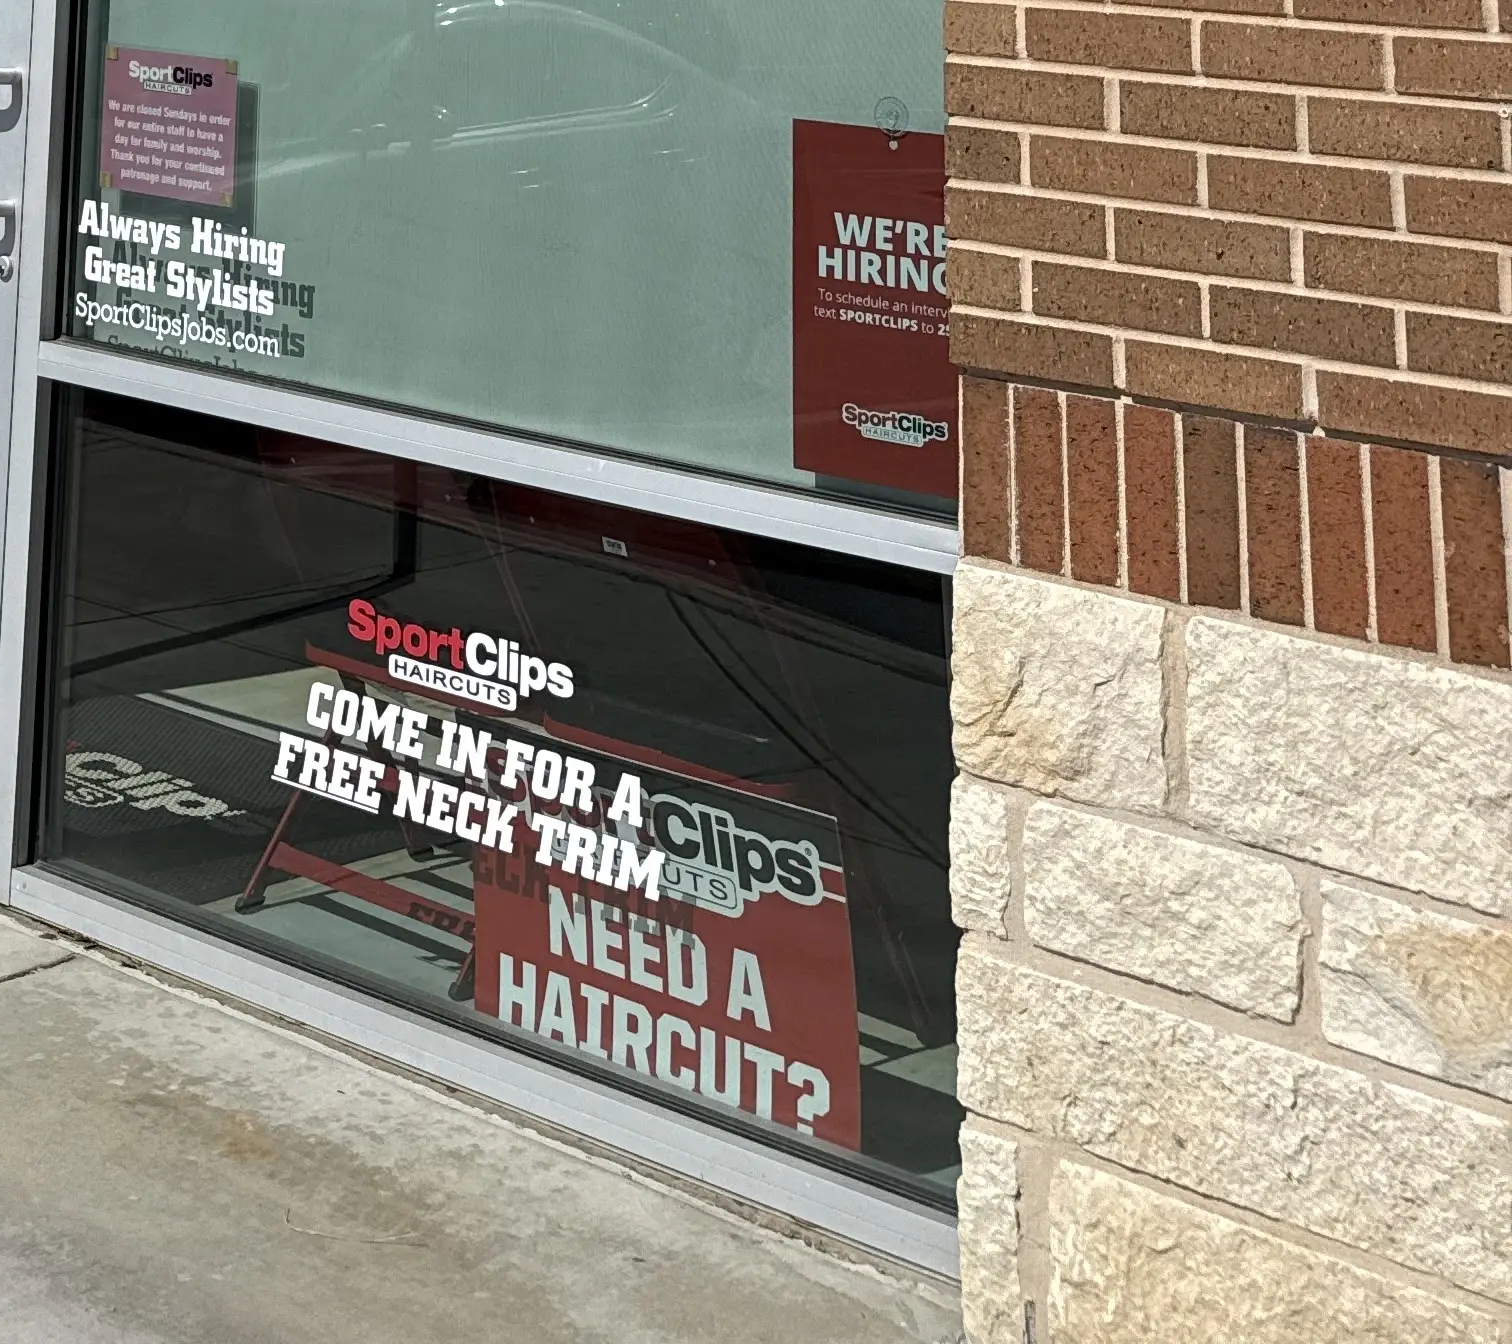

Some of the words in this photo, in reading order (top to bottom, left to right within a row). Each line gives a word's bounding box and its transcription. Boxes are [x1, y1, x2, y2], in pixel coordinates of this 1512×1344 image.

[144, 82, 190, 94] HAIRCUTS
[108, 99, 120, 110] We
[122, 103, 135, 113] are
[136, 104, 162, 117] closed
[163, 107, 197, 123] Sundays
[199, 112, 207, 122] in
[209, 114, 231, 126] order
[114, 116, 125, 128] for
[127, 120, 140, 129] our
[142, 121, 165, 134] entire
[167, 125, 185, 137] staff
[186, 127, 195, 138] to
[197, 128, 216, 141] have
[110, 148, 134, 161] Thank
[135, 154, 150, 166] you
[151, 155, 162, 167] for
[164, 158, 183, 170] your
[184, 161, 225, 177] continued
[114, 132, 128, 147] day
[130, 135, 142, 147] for
[143, 137, 168, 152] family
[169, 142, 185, 153] and
[186, 144, 222, 160] worship.
[120, 168, 160, 184] patronage
[161, 174, 177, 186] and
[178, 177, 213, 192] support.
[78, 198, 181, 255] Always
[191, 216, 286, 277] Hiring
[833, 211, 947, 259] WE'RE
[84, 245, 156, 293] Great
[166, 260, 275, 316] Stylists
[813, 305, 836, 320] text
[839, 309, 919, 332] SPORTCLIPS
[921, 322, 935, 335] to
[817, 287, 833, 302] To
[835, 292, 890, 310] schedule
[892, 301, 908, 313] an
[911, 301, 949, 319] interv
[75, 292, 281, 358] SportClipsJobs.com
[844, 405, 946, 439] SportClips
[864, 426, 920, 444] HAIRCUTS
[347, 599, 574, 699] SportClips
[394, 658, 512, 705] HAIRCUTS
[306, 681, 428, 760] COME
[435, 714, 492, 781] IN
[500, 738, 596, 813] FOR
[607, 773, 643, 827] A
[273, 731, 388, 809] FREE
[392, 771, 518, 854] NECK
[531, 813, 666, 902] TRIM
[548, 884, 708, 1007] NEED
[726, 947, 772, 1032] A
[497, 952, 831, 1137] HAIRCUT?
